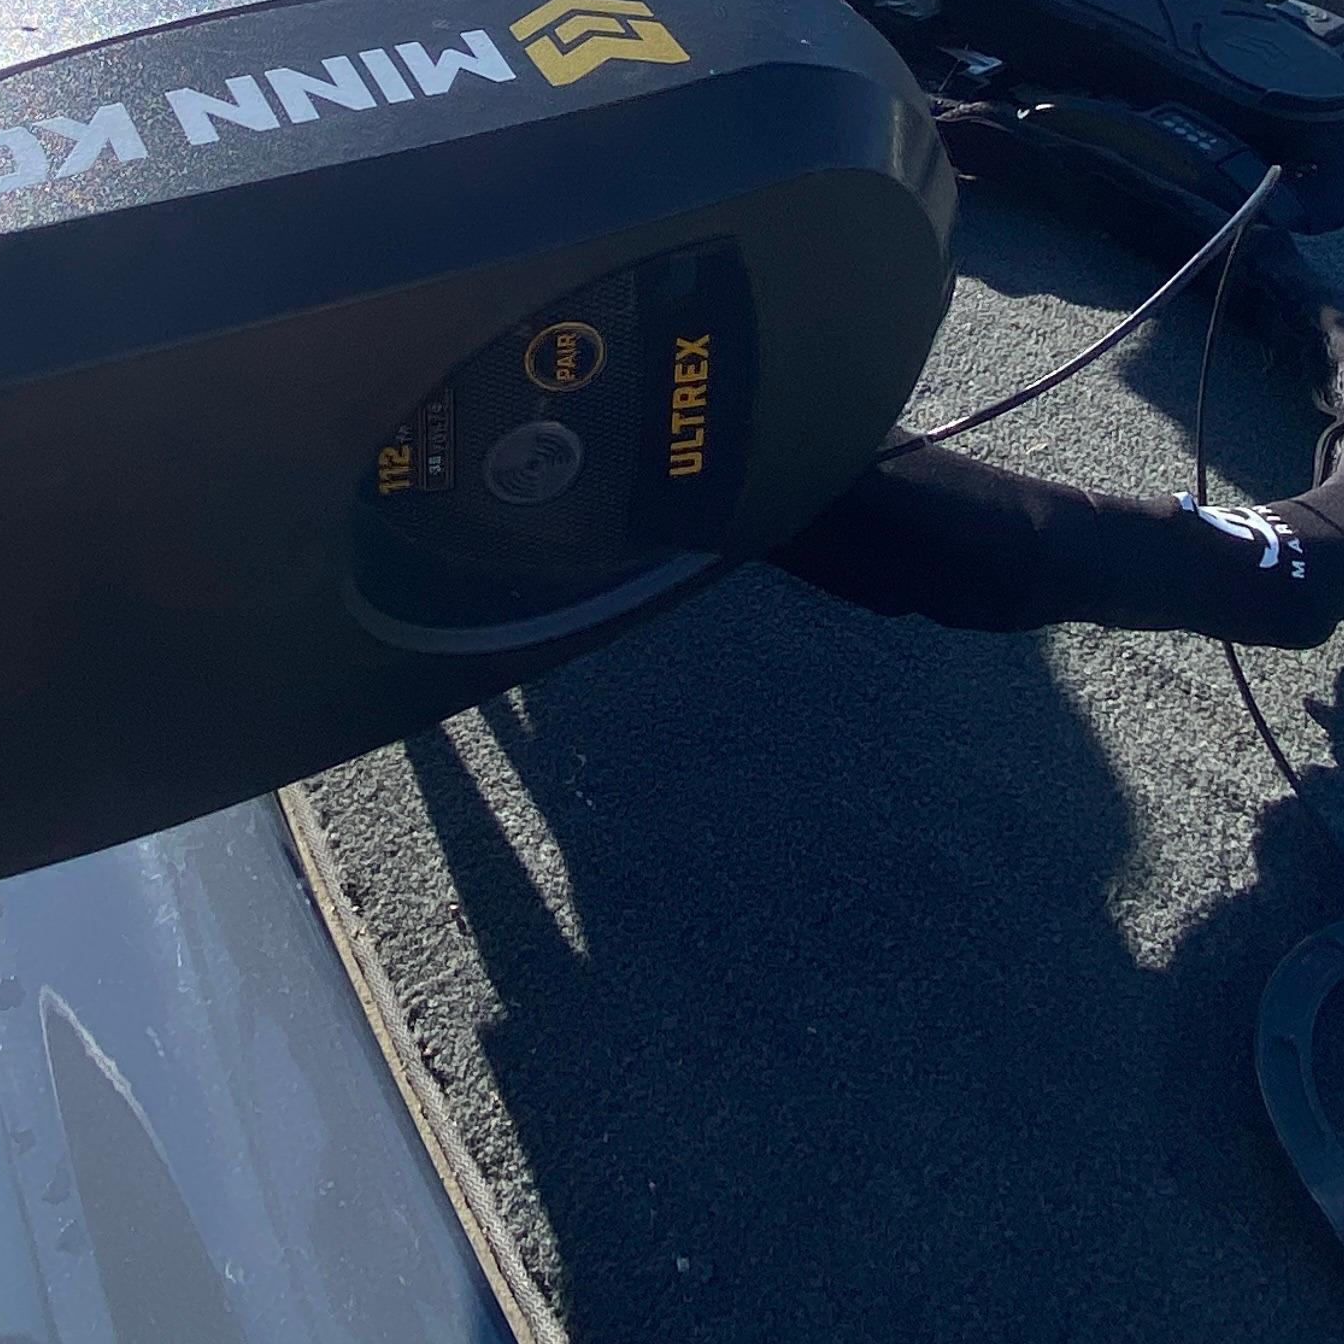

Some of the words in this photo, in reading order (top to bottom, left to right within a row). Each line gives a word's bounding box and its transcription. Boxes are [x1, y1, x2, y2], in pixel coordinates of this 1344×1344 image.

[165, 29, 515, 146] MINN
[556, 333, 577, 382] PAIR
[669, 334, 710, 477] ULTREX
[377, 445, 414, 495] 112
[1253, 505, 1306, 579] MARIN
